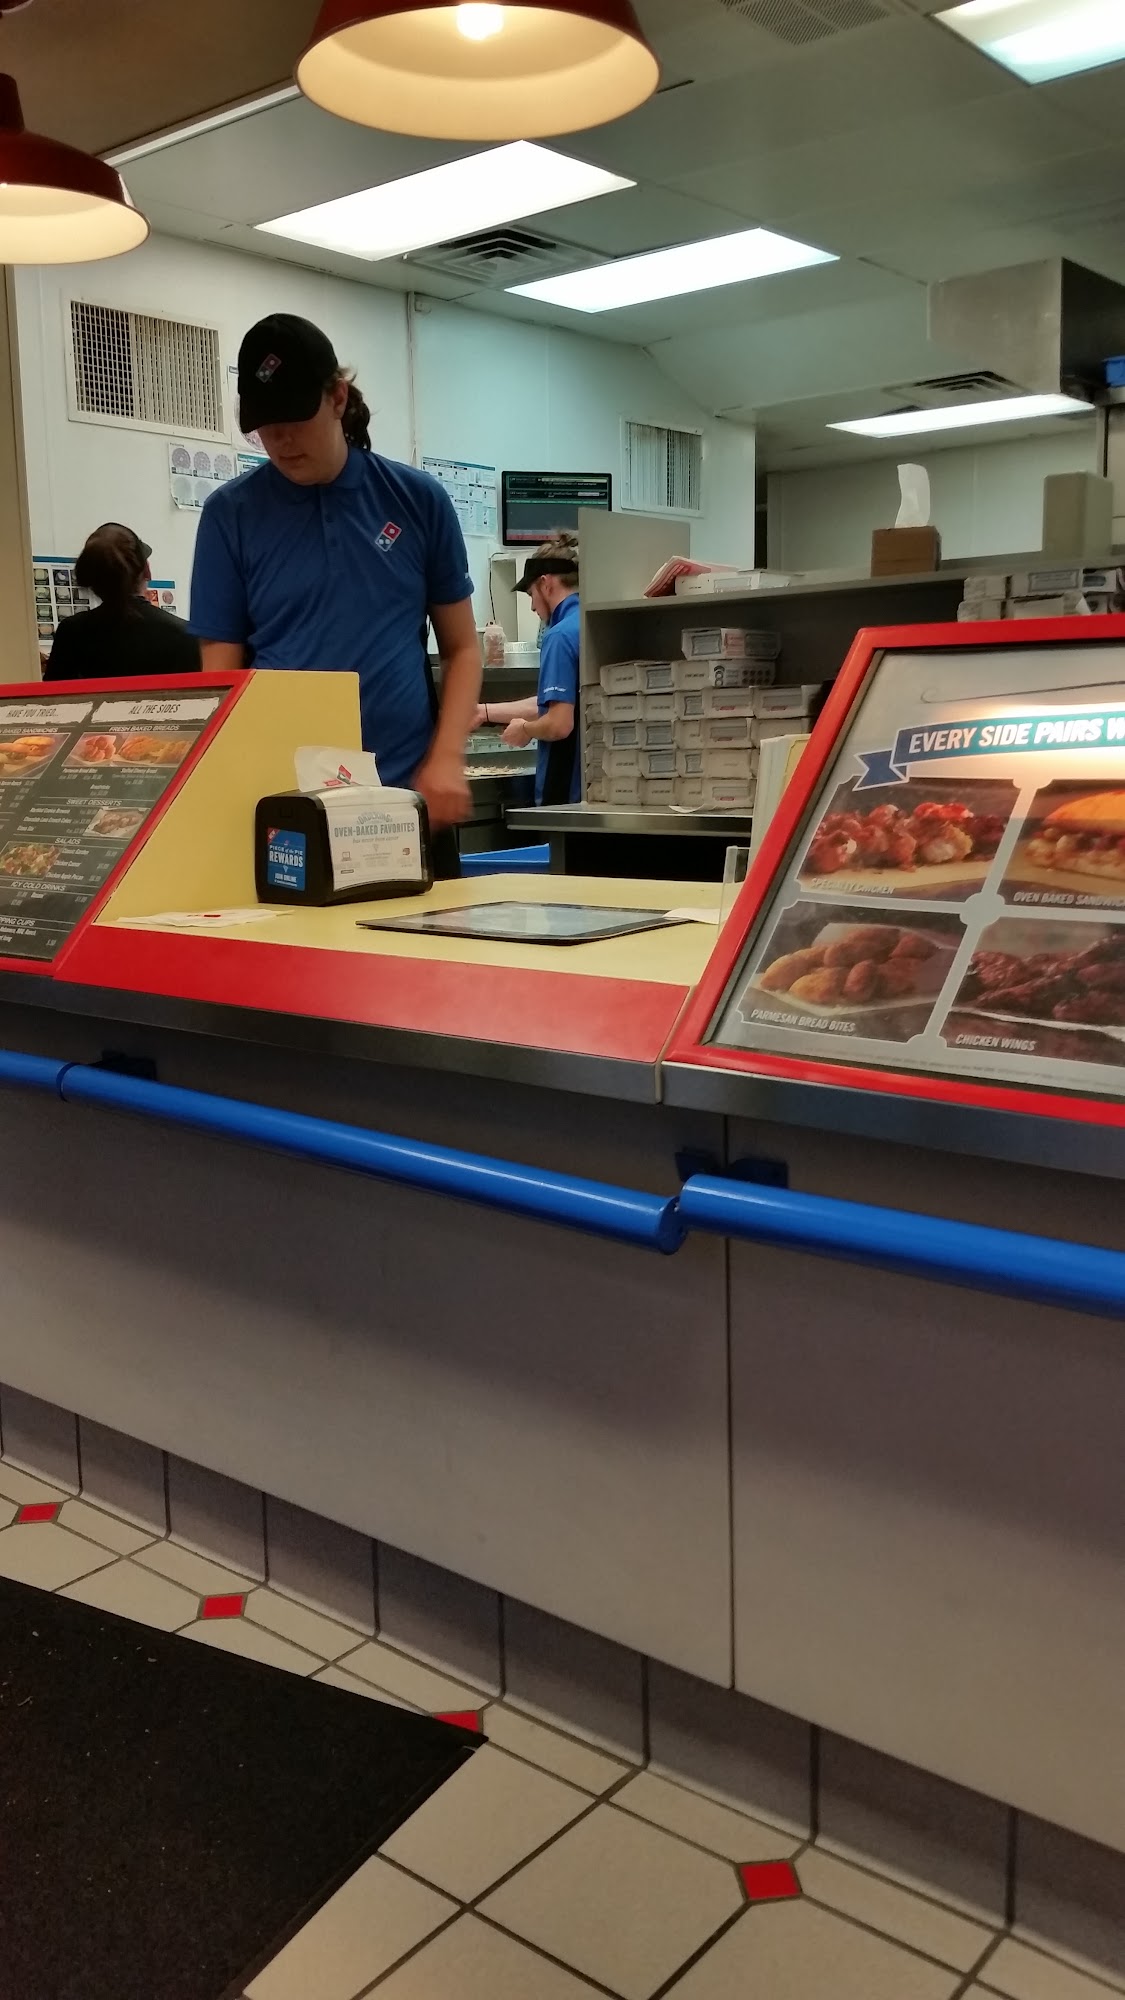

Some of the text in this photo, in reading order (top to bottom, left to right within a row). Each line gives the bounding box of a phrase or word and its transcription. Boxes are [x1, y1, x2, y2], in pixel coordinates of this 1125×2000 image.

[23, 709, 37, 717] YOU
[129, 704, 181, 714] ALL THE SIDES
[908, 727, 977, 754] EVERY
[979, 723, 1033, 747] SIDE
[1034, 718, 1104, 744] PAIRS
[334, 822, 415, 838] OVEN-BAKED FAVORITES
[55, 837, 81, 845] SALADS
[269, 850, 303, 867] REWARDS
[1013, 892, 1040, 903] OVEN
[1041, 893, 1075, 904] BAKED
[750, 1009, 856, 1032] PARMESAN BREAD BITES
[955, 1034, 1036, 1051] CHICKEN WINGS
